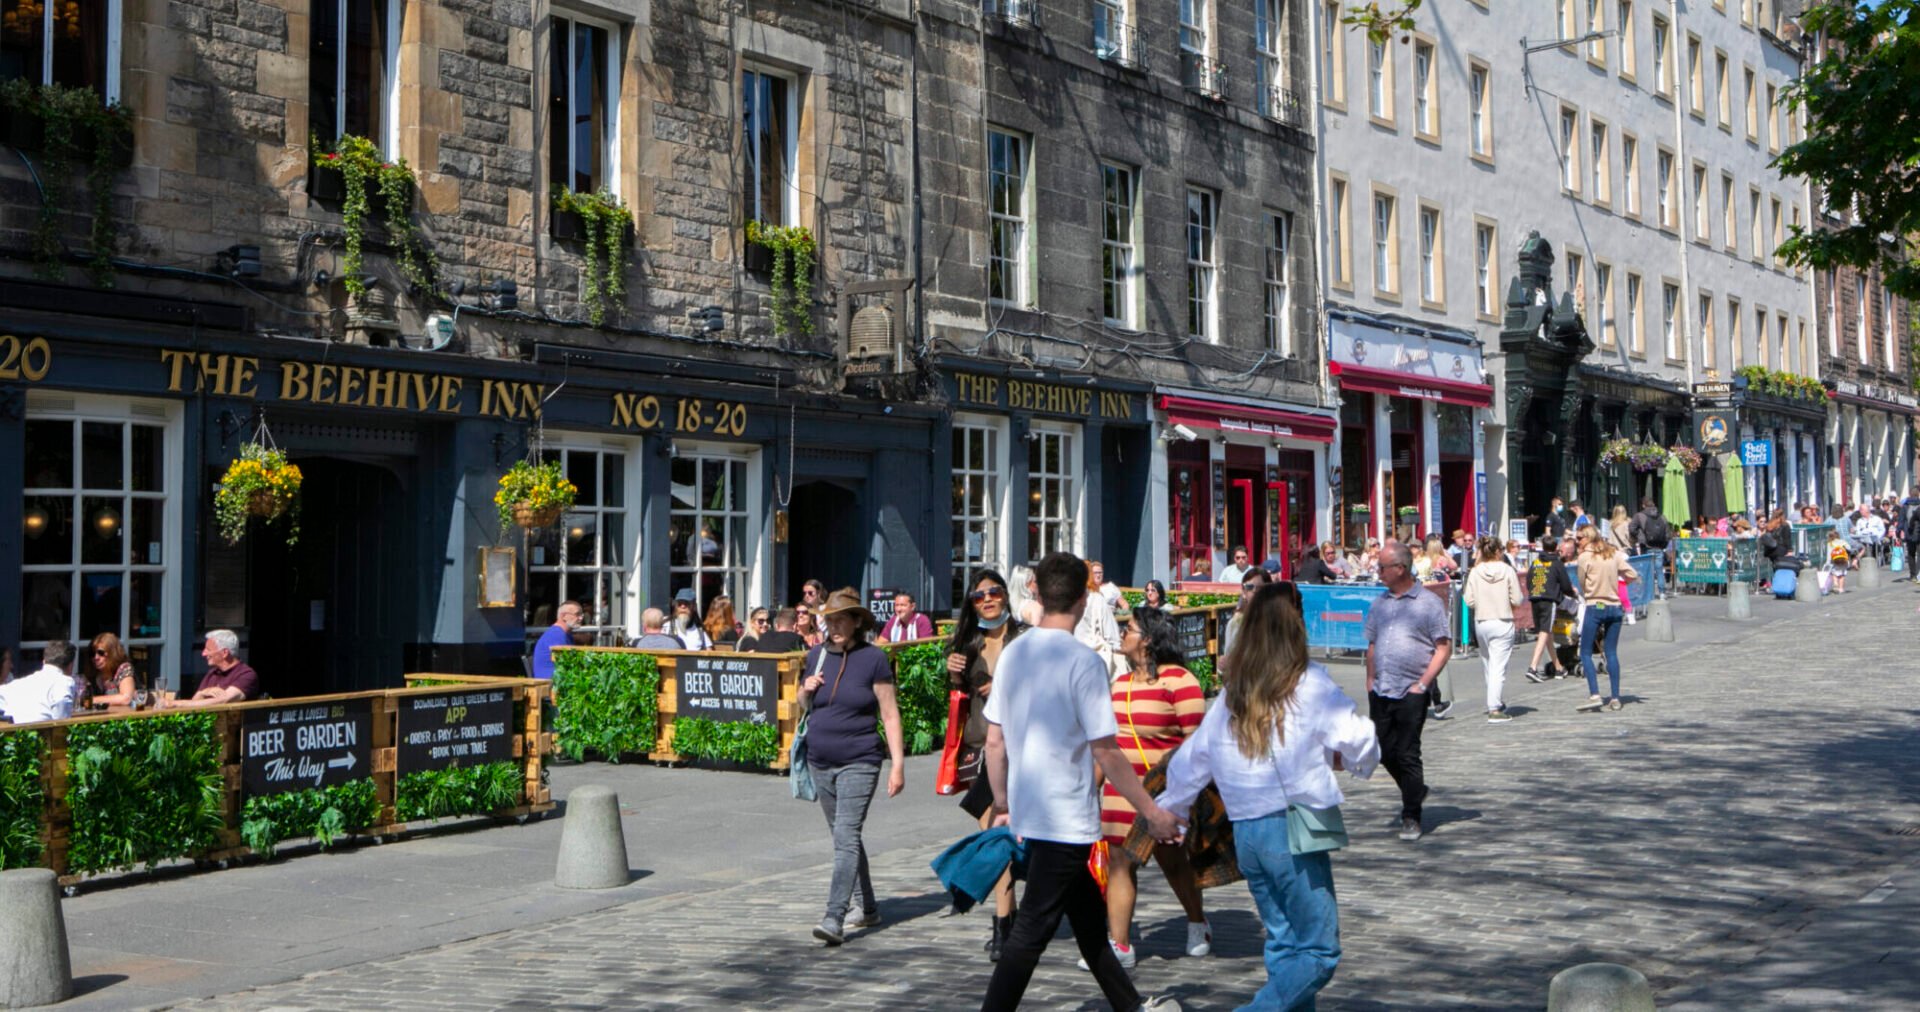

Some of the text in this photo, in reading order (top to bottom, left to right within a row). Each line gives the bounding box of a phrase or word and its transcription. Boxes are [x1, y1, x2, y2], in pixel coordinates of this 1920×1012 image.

[161, 349, 545, 420] THE BEEHIVE INN
[954, 373, 1132, 419] THE BEEHIVE INN
[610, 392, 747, 437] NO. 18-20
[870, 600, 896, 613] EXIT
[684, 672, 764, 697] BEER GARDEN
[298, 709, 304, 721] A
[331, 705, 345, 718] BIG
[413, 697, 448, 710] DOWNLOAD
[451, 695, 465, 706] OUR
[723, 698, 733, 709] VIA
[734, 699, 744, 710] THE
[745, 699, 758, 711] BAR
[445, 706, 468, 724] APP
[248, 720, 357, 757] BEER GARDEN
[410, 730, 432, 745] ORDER
[437, 728, 453, 742] PAY
[461, 726, 478, 739] FOOD
[481, 722, 505, 737] DRINKS
[432, 740, 488, 759] BOOK YOUR TABLE
[264, 756, 325, 787] This Way
